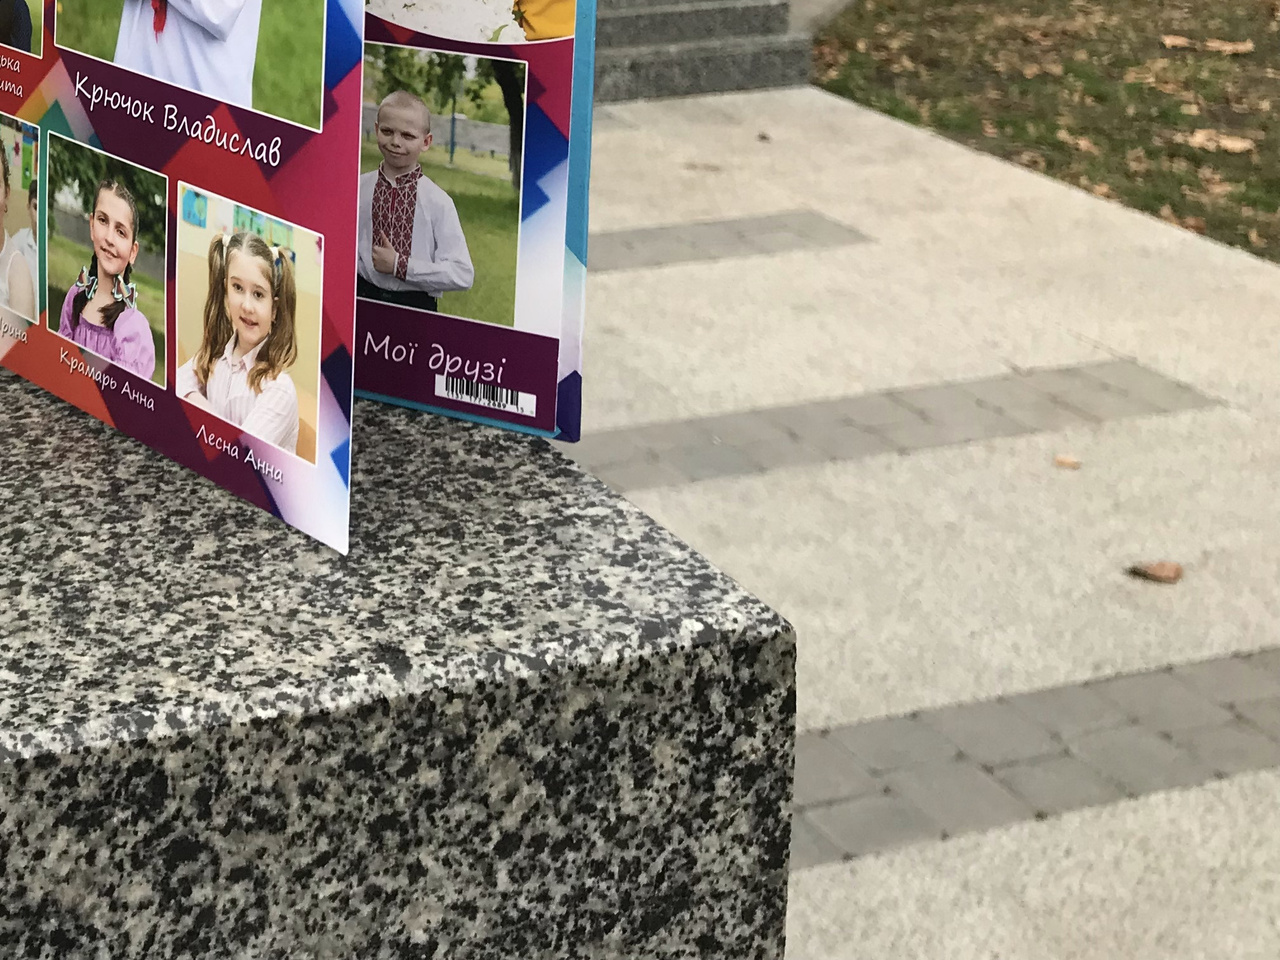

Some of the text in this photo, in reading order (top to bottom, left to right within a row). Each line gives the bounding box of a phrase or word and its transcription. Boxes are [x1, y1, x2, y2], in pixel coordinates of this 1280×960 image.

[74, 70, 282, 167] Крючок Владислав
[0, 317, 28, 344] Ірина
[364, 331, 507, 384] Мої друзі
[59, 347, 155, 412] Крамарь Анна
[196, 424, 284, 484] Лесна Анна
